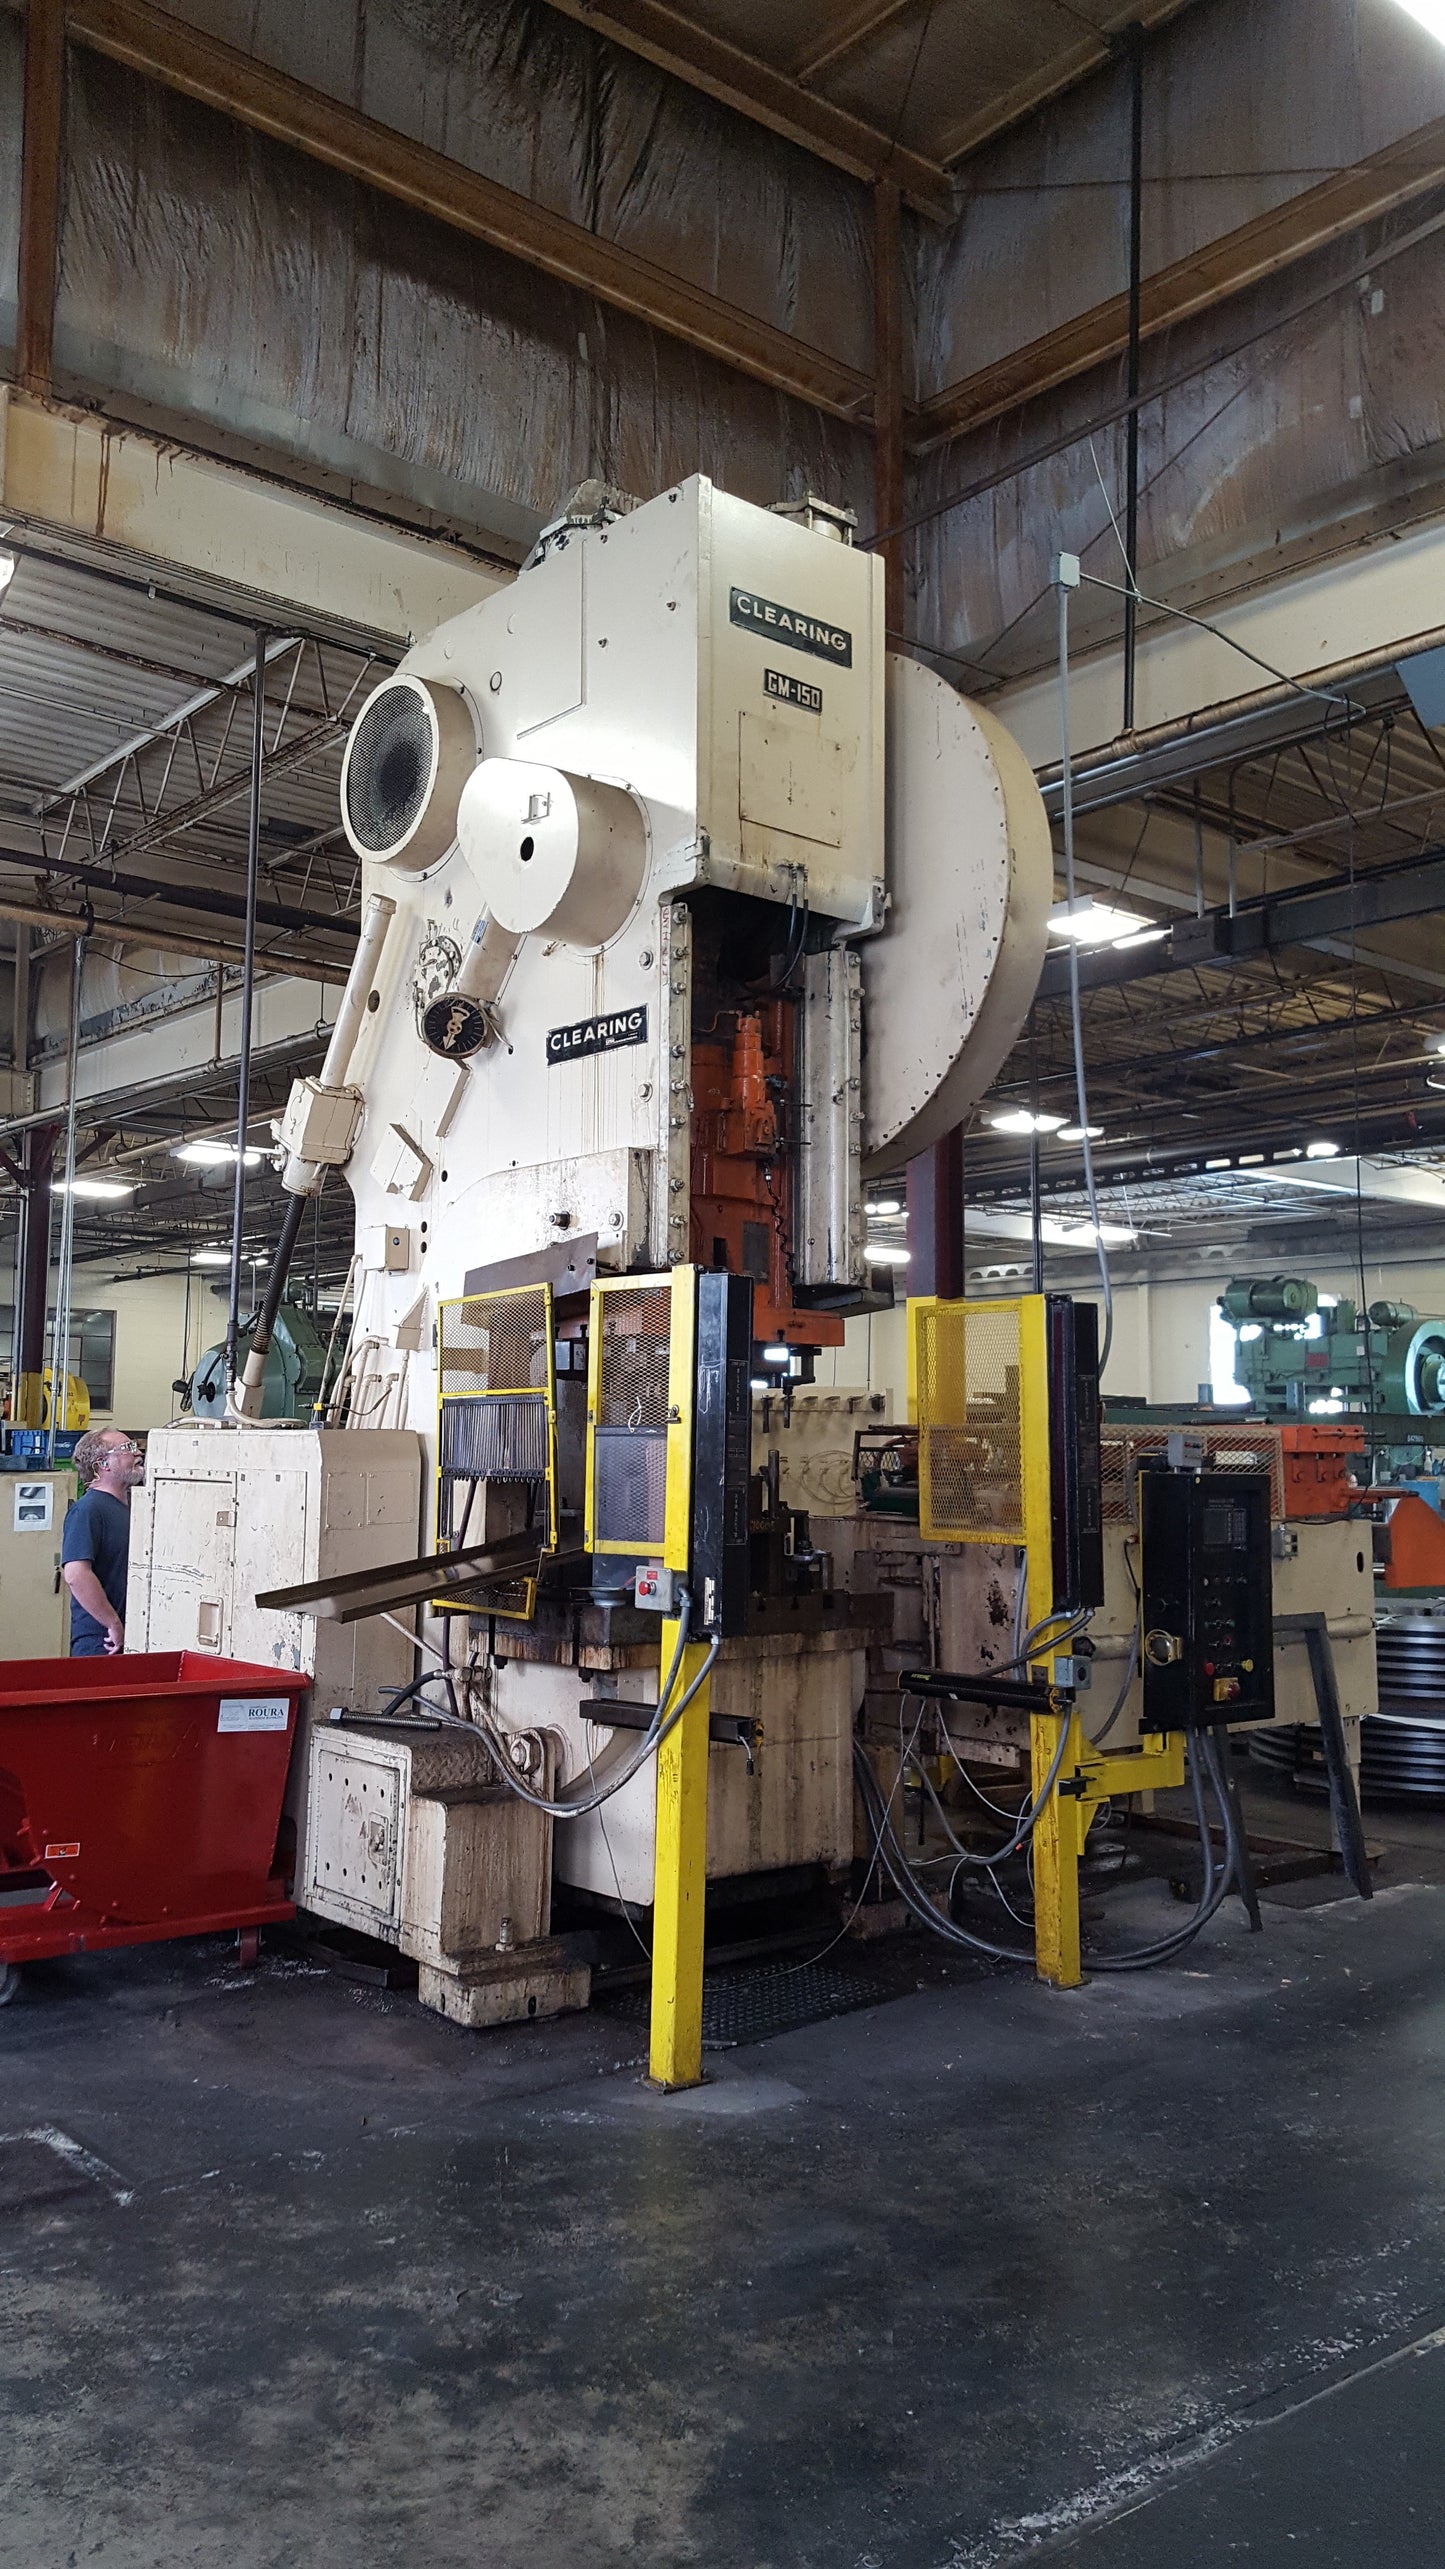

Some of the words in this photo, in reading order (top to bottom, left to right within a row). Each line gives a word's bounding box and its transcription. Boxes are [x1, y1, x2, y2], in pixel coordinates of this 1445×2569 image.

[737, 596, 847, 651] CLEARING
[768, 672, 821, 709] GM-150
[550, 1012, 643, 1051] CLEARING
[248, 1708, 284, 1717] ROURA
